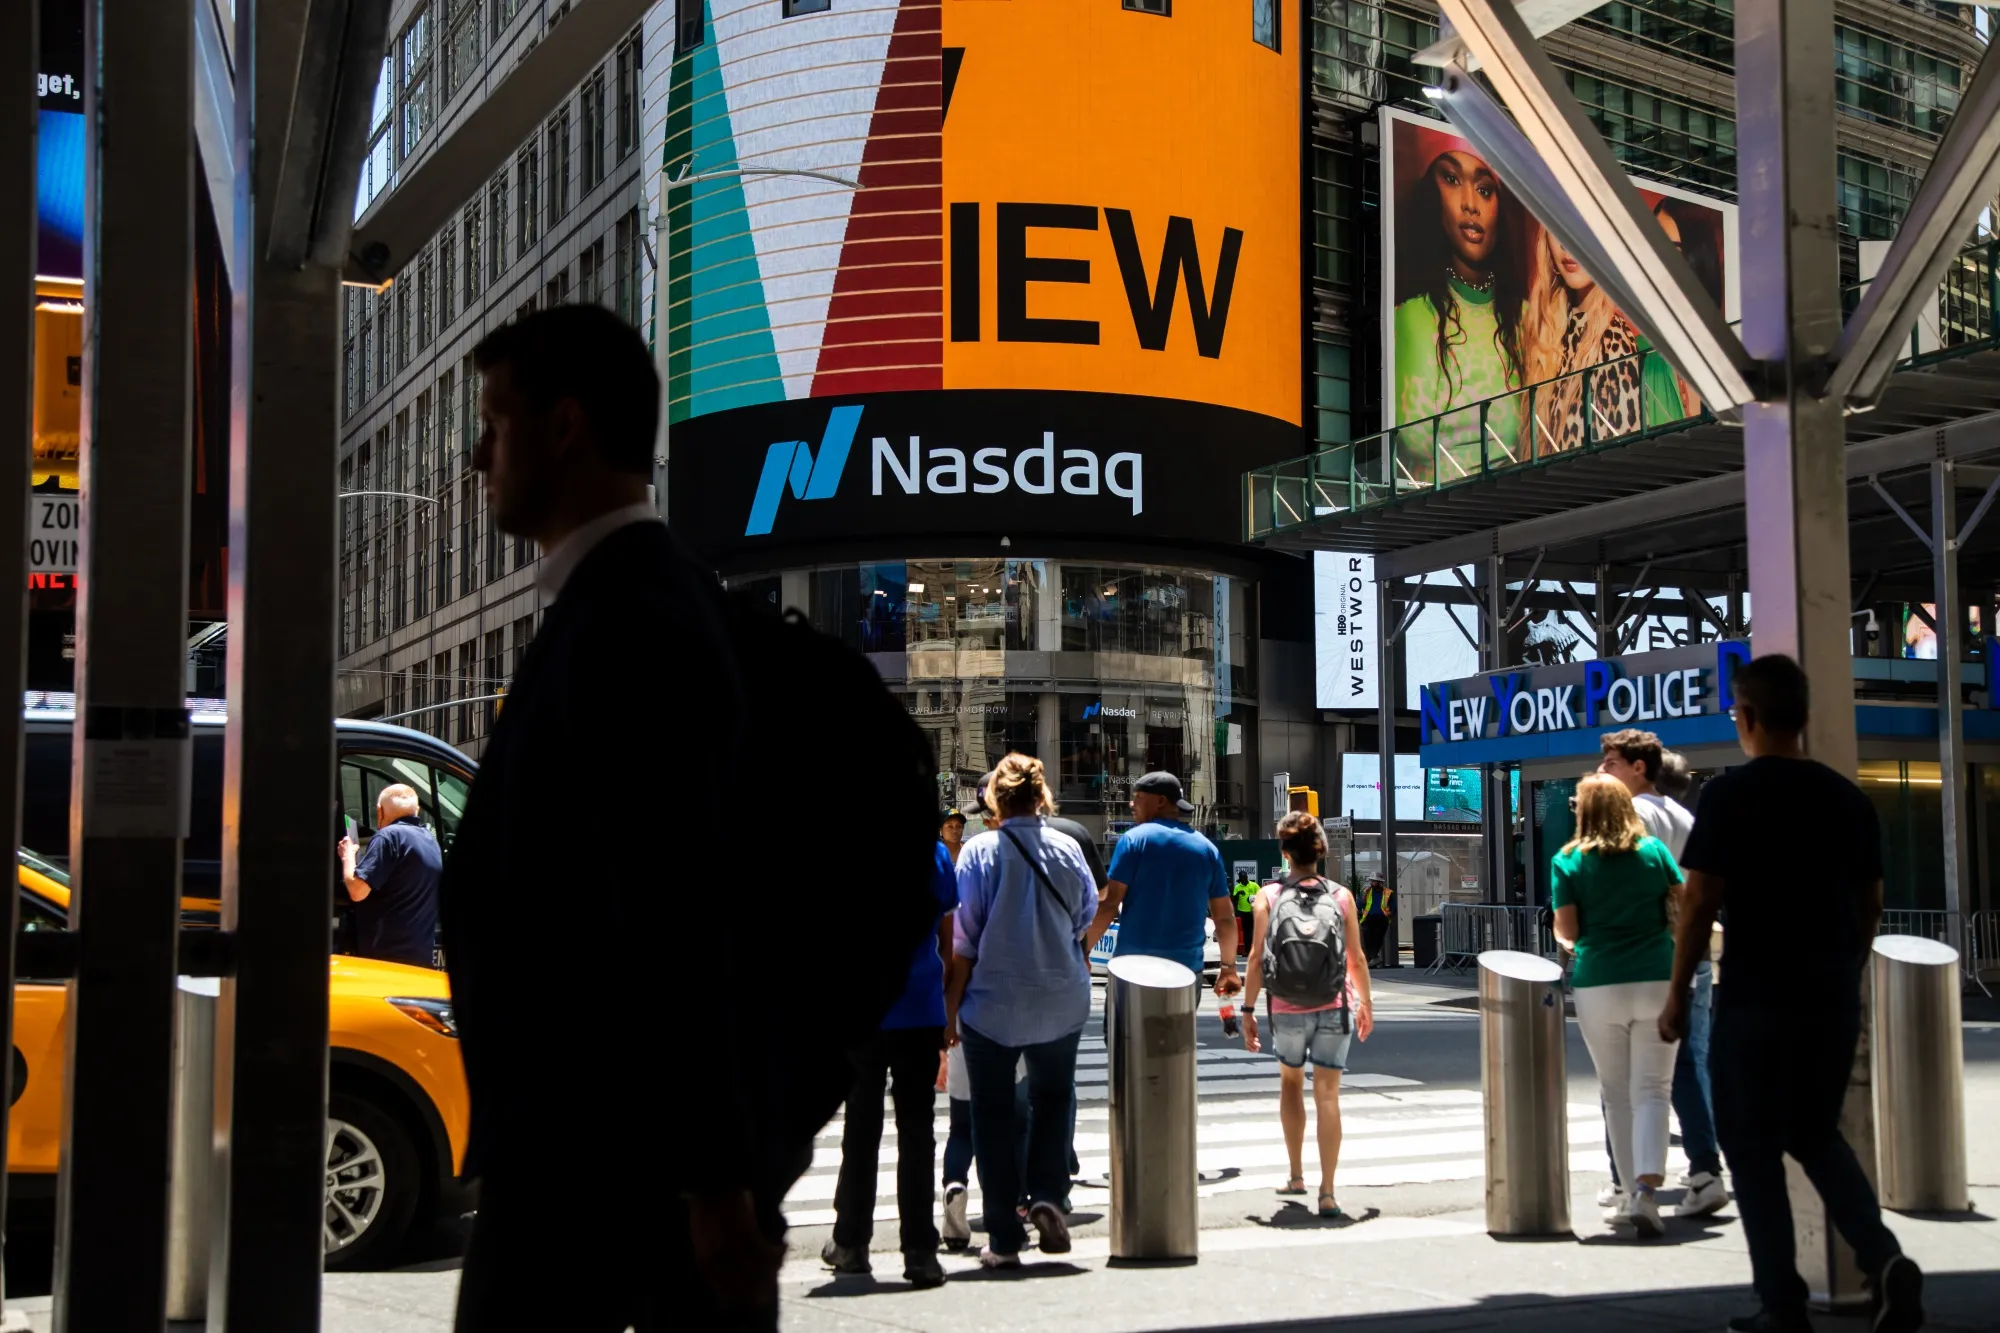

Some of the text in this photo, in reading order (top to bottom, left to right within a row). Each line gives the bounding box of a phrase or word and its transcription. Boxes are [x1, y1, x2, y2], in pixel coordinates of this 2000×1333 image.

[871, 431, 1144, 517] Nasdaq
[1337, 614, 1347, 636] HBO
[1349, 557, 1364, 697] WESTWOR
[1101, 706, 1136, 719] Nasdaq
[1489, 673, 1577, 738] YORK
[1585, 661, 1702, 727] POLICE
